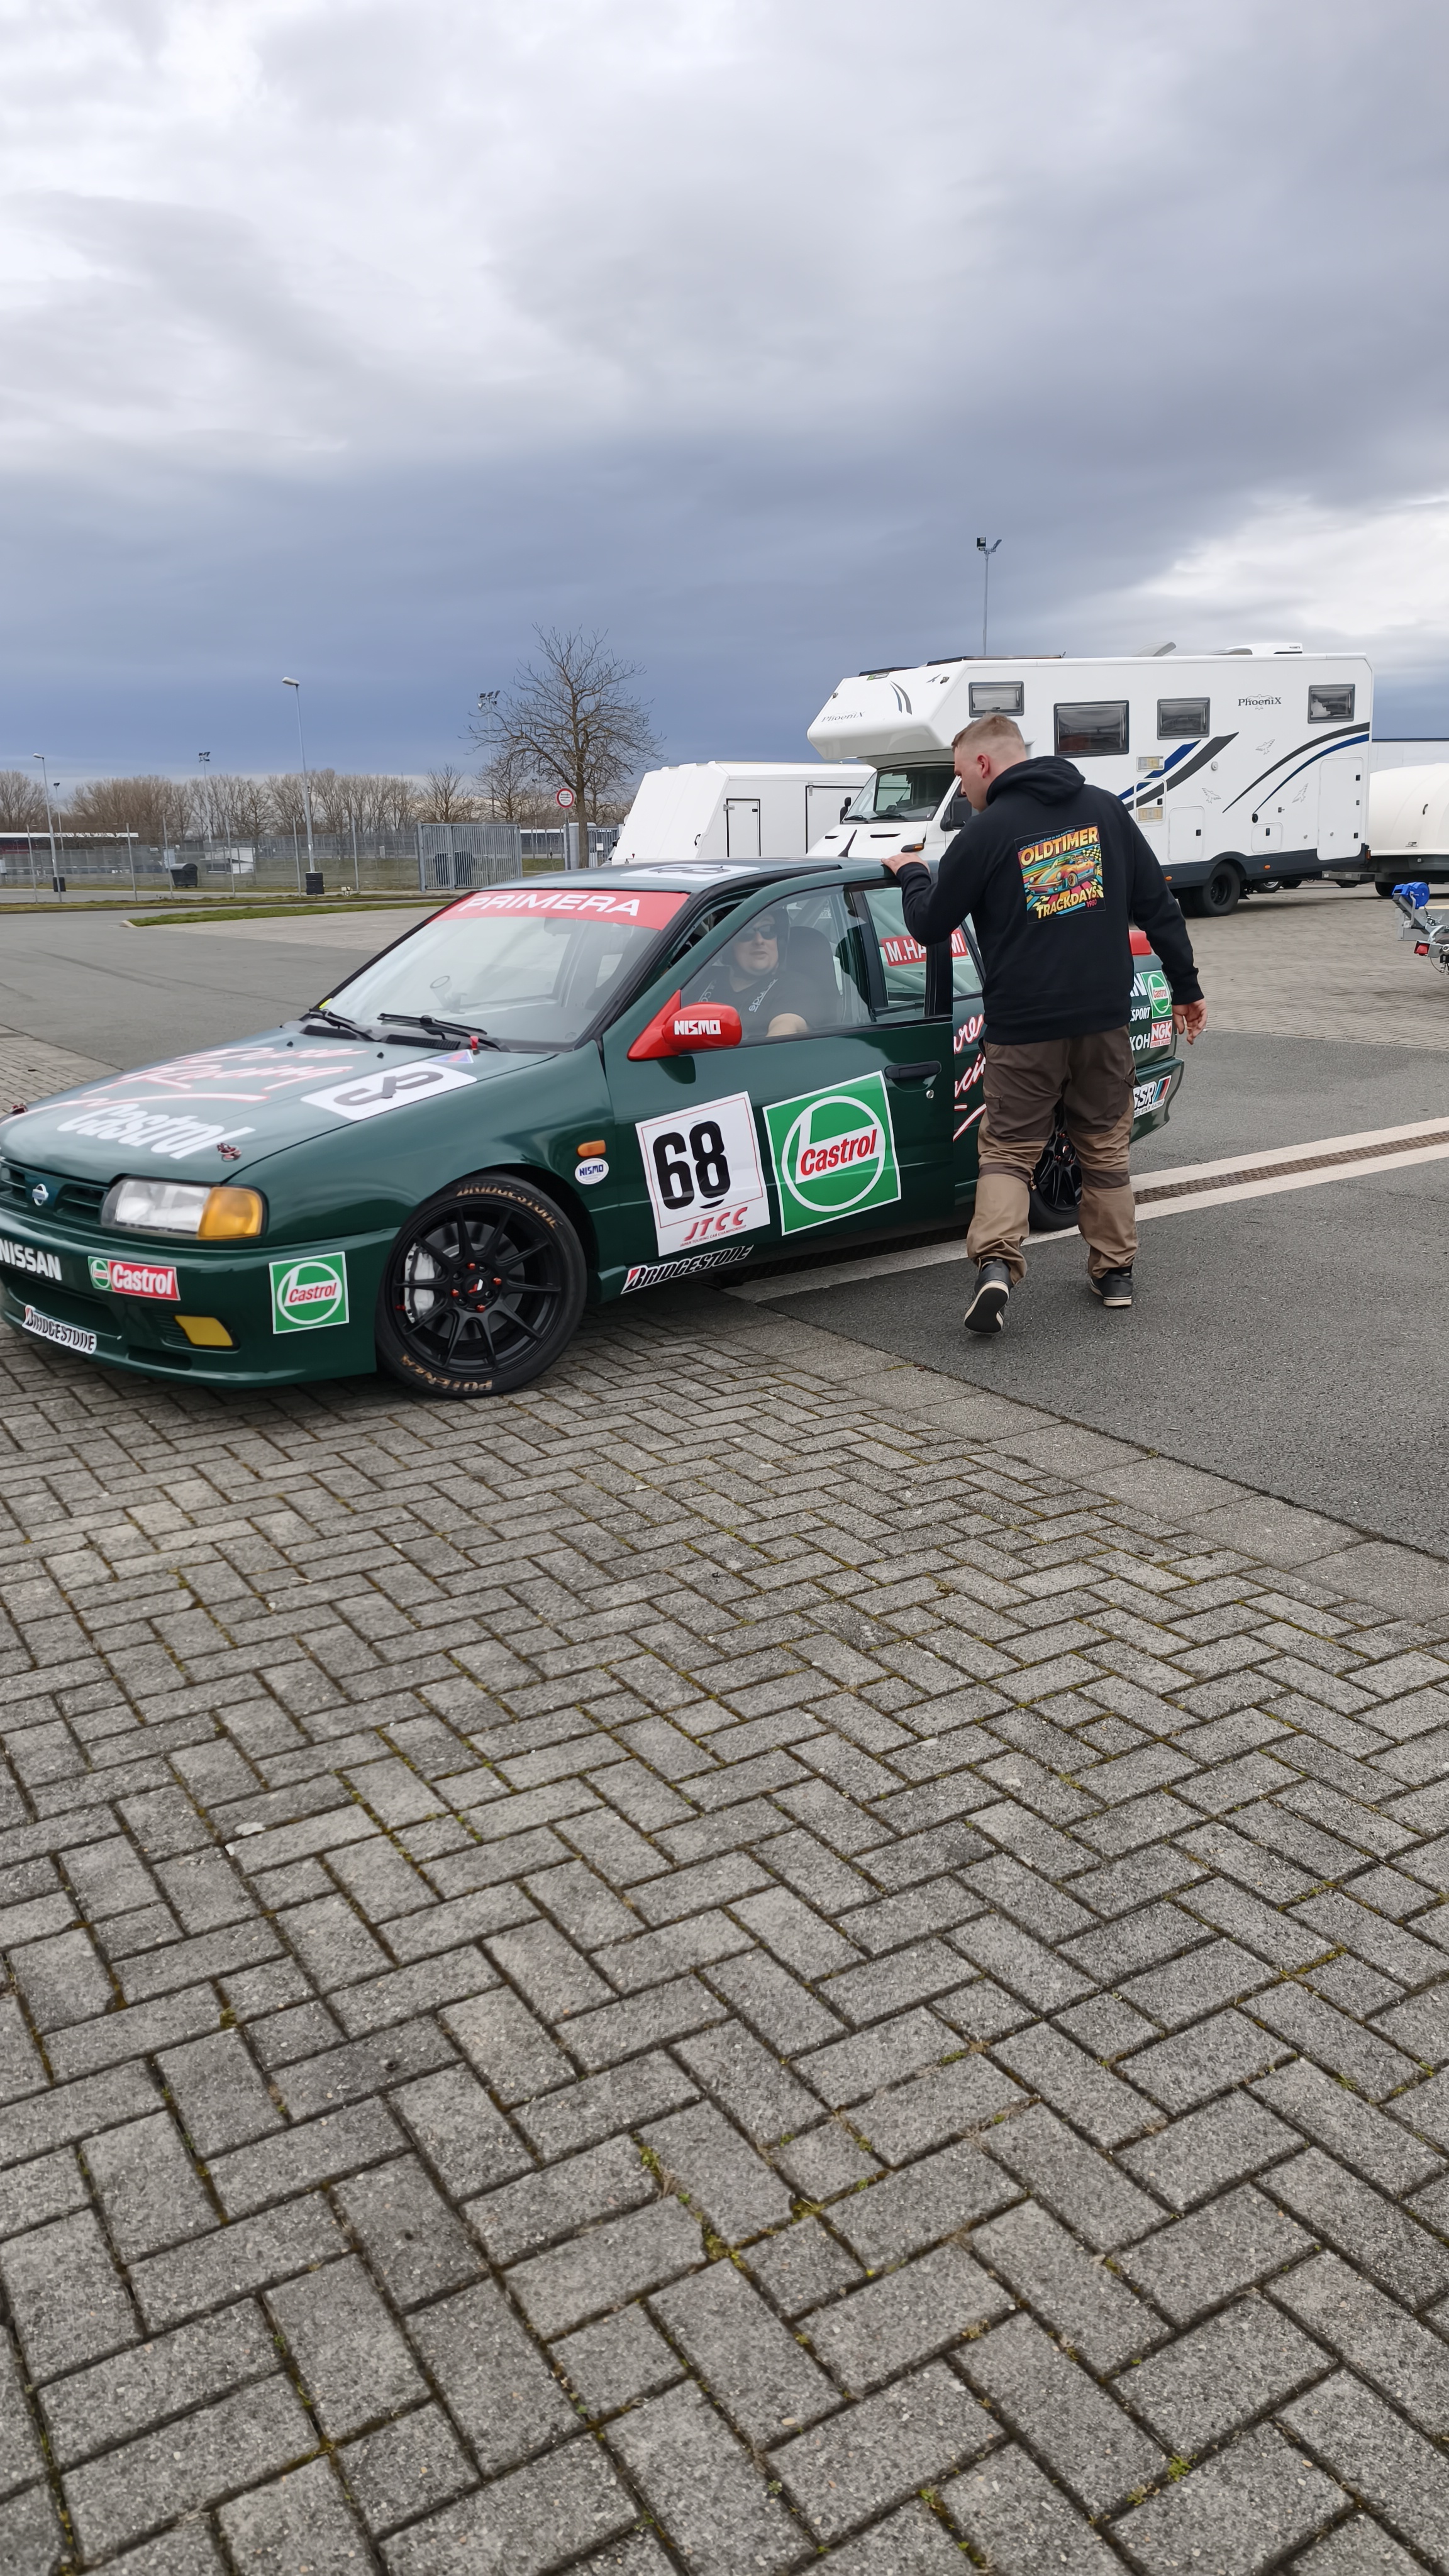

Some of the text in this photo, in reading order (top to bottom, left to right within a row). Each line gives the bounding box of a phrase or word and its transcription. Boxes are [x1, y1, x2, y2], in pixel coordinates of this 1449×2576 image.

[1021, 826, 1099, 865] OLDTIMER
[458, 894, 640, 916] PRIMERA
[1036, 886, 1097, 919] TRACKDAYS
[674, 1019, 721, 1035] NISMO
[1151, 1021, 1172, 1041] NGK
[57, 1103, 256, 1159] Castrol
[653, 1121, 731, 1210] 68
[801, 1129, 877, 1175] Castrol
[579, 1164, 604, 1176] NISMO
[684, 1206, 748, 1241] JTCC
[0, 1238, 62, 1280] NISSAN
[624, 1246, 753, 1291] BRIDGESTONE
[112, 1264, 173, 1294] Castrol
[289, 1282, 337, 1302] Castrol
[25, 1306, 94, 1351] BRIDGESTONE
